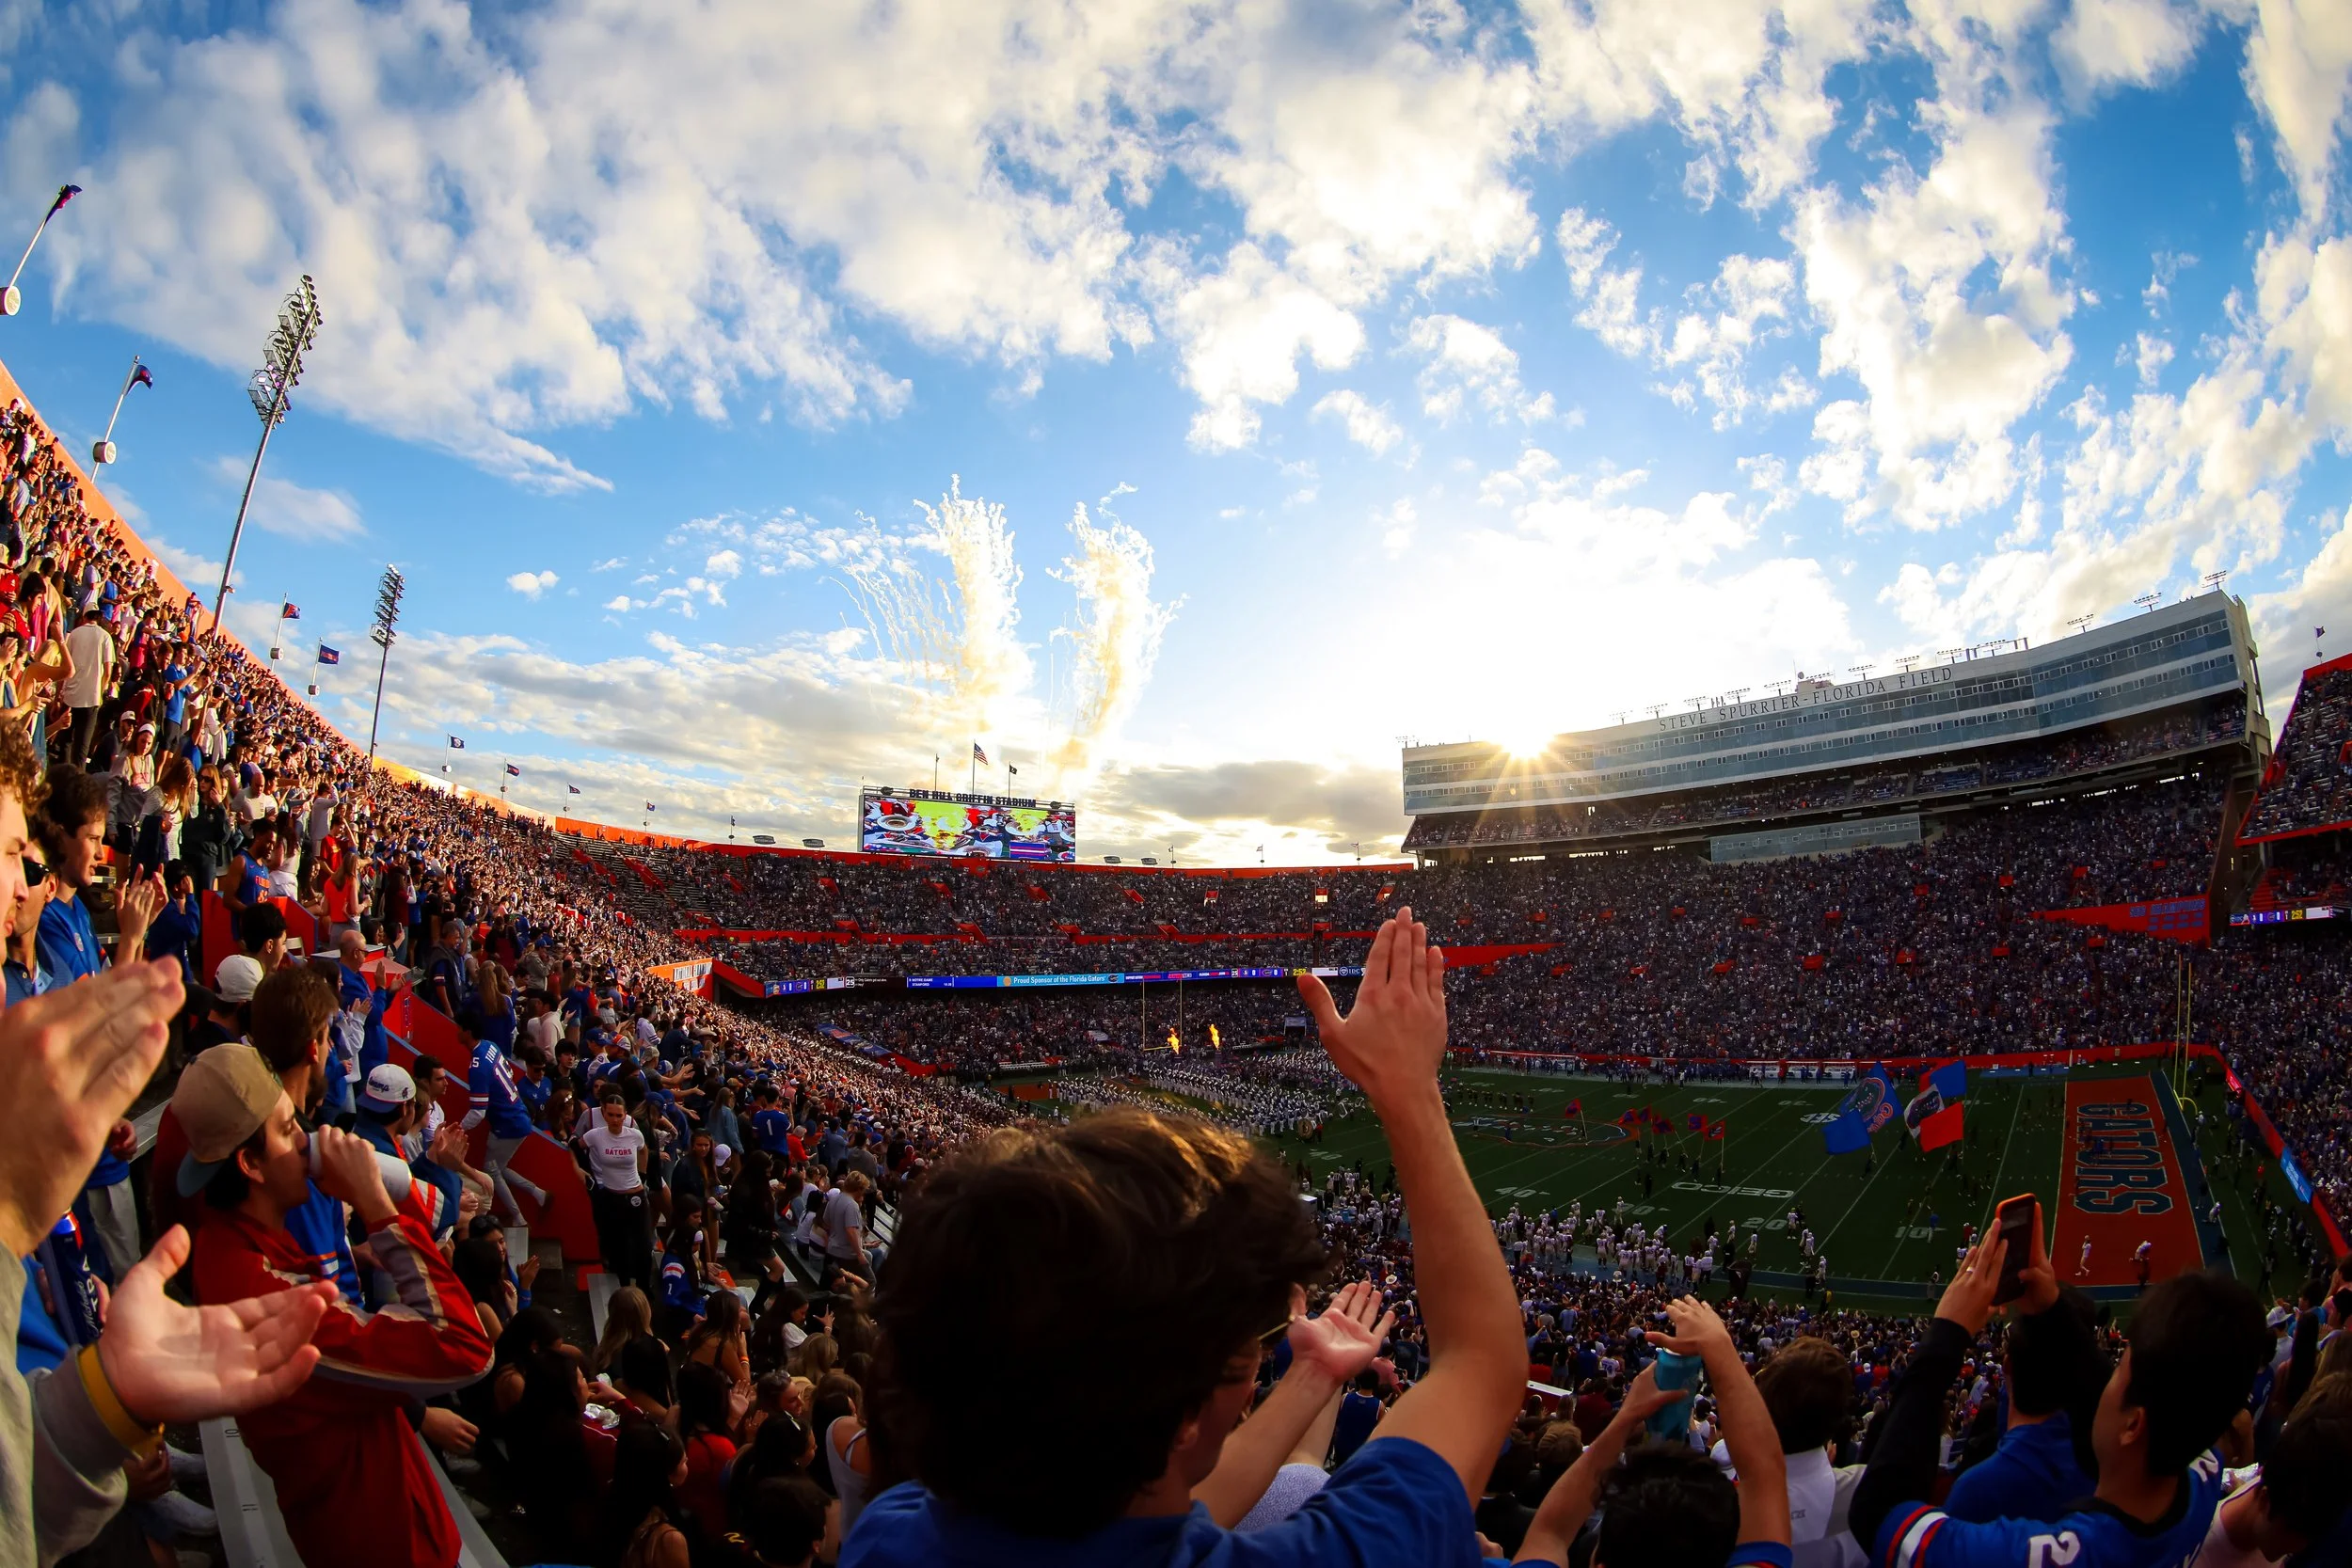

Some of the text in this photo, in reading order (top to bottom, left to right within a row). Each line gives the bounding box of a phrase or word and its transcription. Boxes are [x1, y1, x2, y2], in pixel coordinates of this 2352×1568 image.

[1659, 712, 1707, 732] STEVE
[1899, 667, 1953, 689] FIELD
[910, 789, 1036, 808] BEN HILL GRIFFIN STADIUM
[1030, 976, 1053, 985] Sponsor
[469, 1056, 480, 1068] 5
[767, 1118, 773, 1136] 1
[2074, 1102, 2173, 1214] GATORS
[1495, 1186, 1537, 1198] 40
[1671, 1181, 1794, 1199] GEICO
[1740, 1217, 1788, 1230] 20
[1894, 1226, 1931, 1239] 10
[225, 1428, 240, 1438] 10
